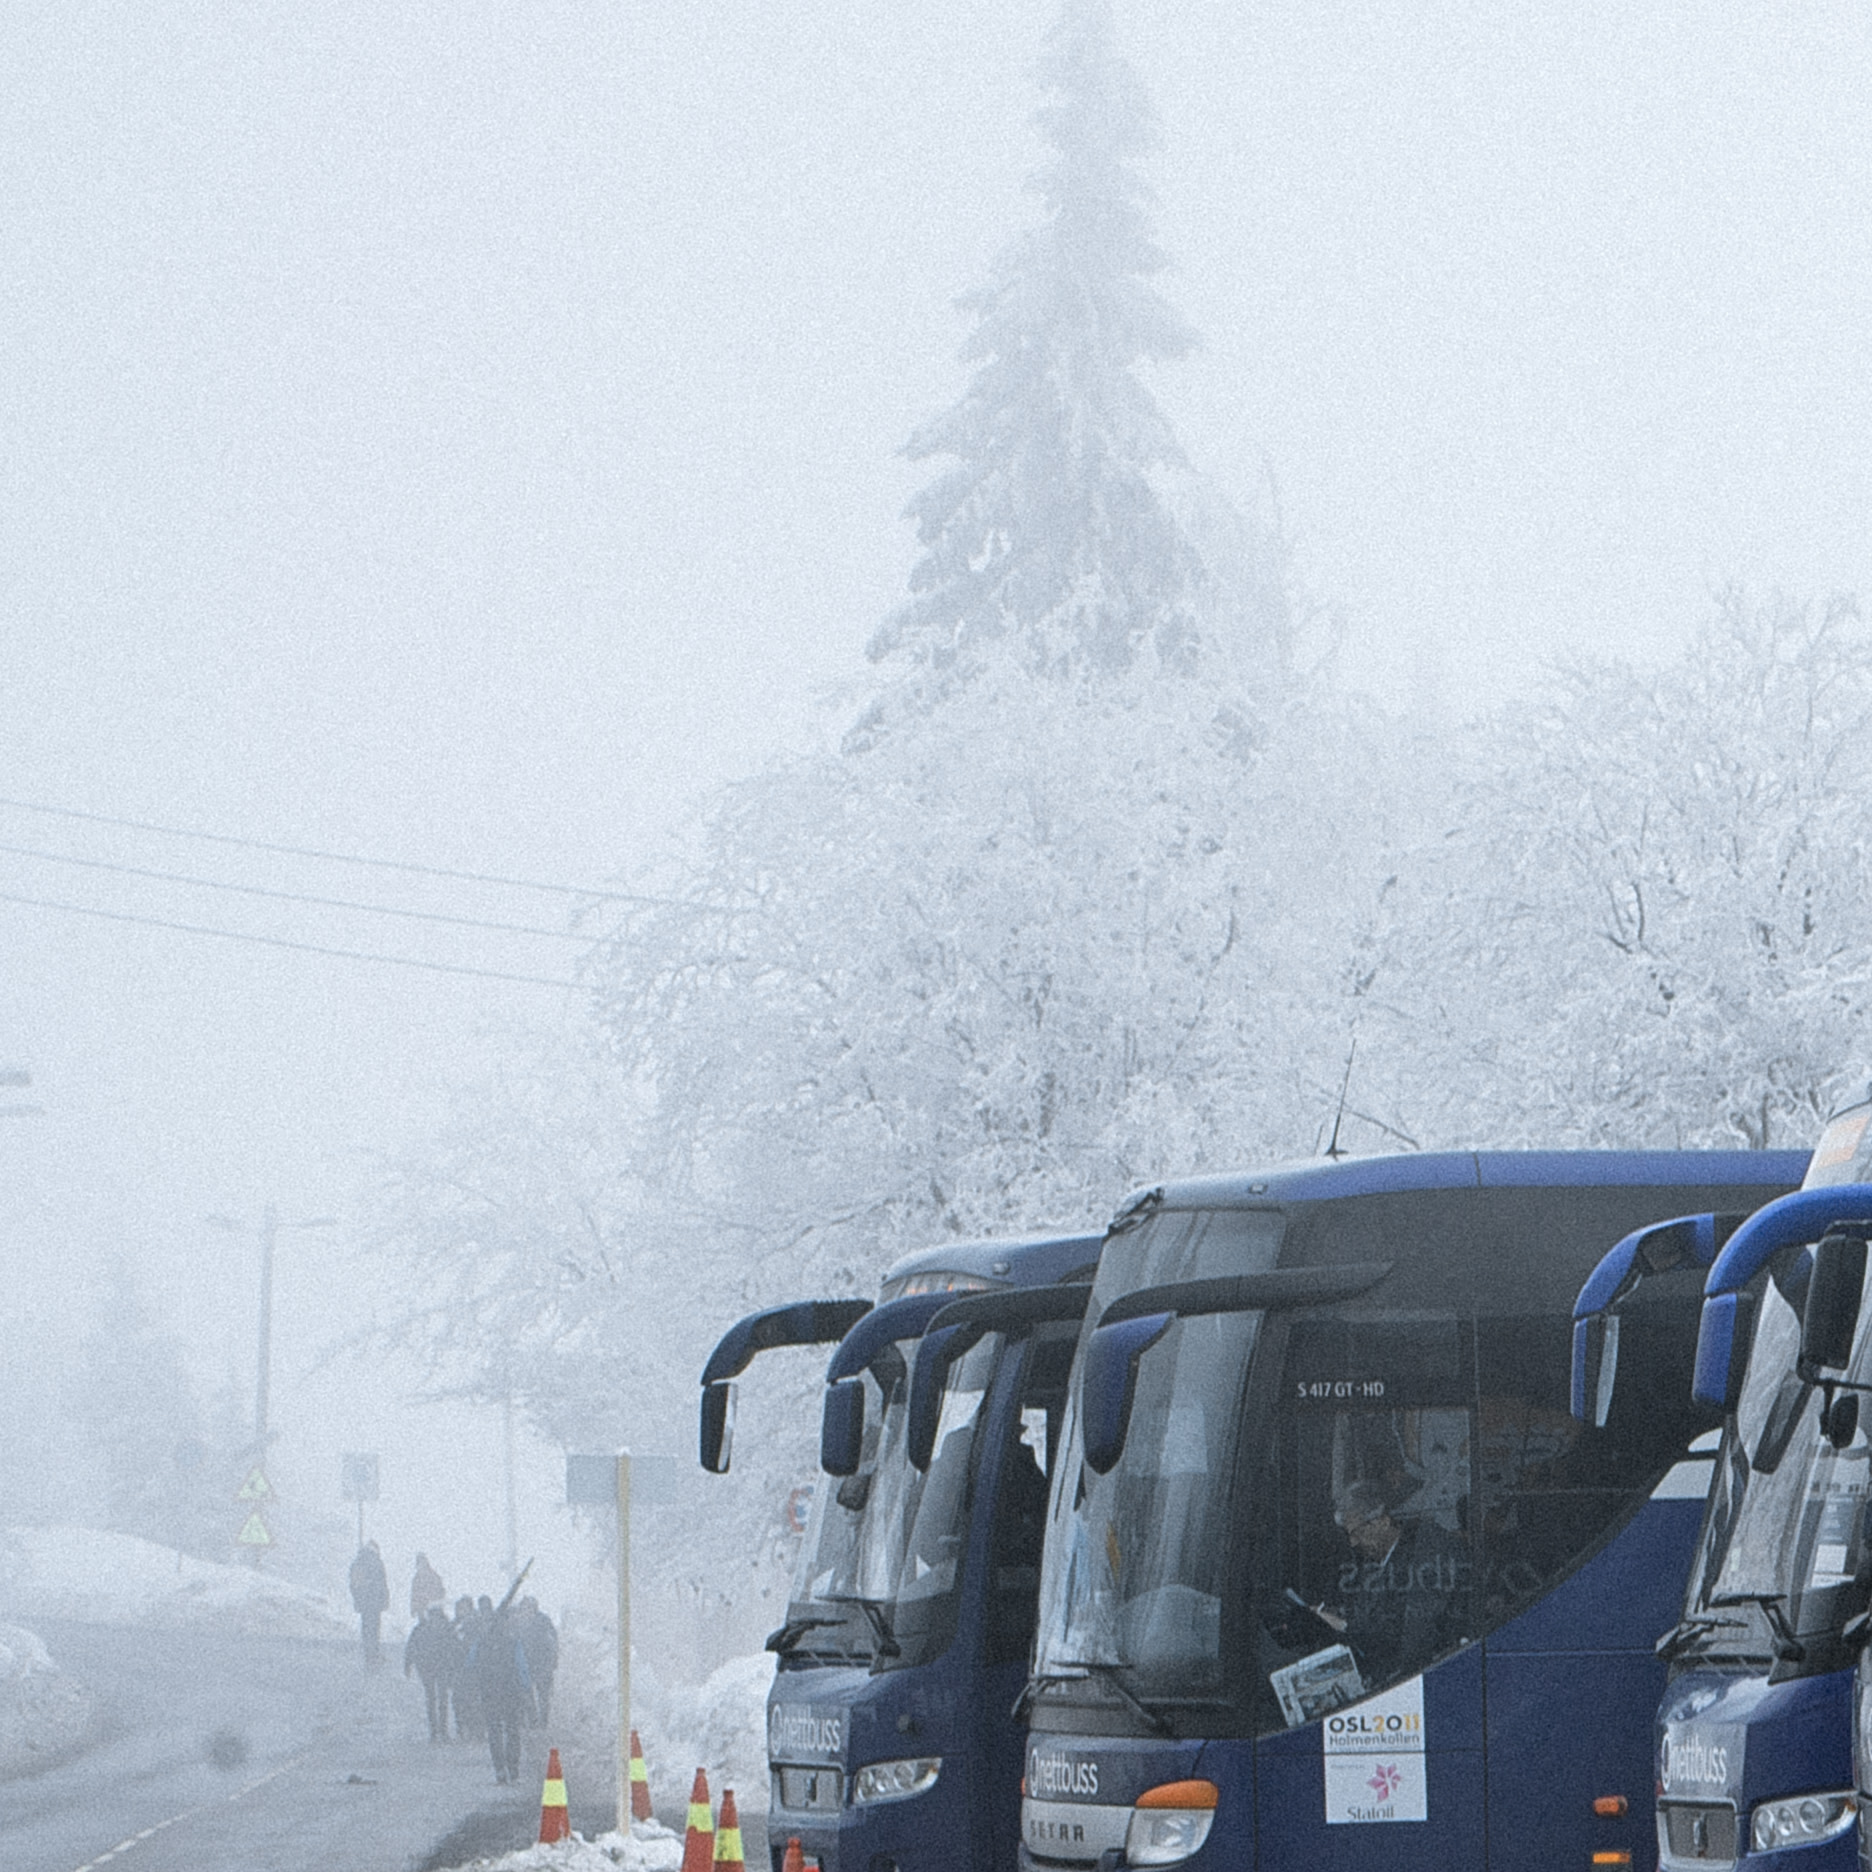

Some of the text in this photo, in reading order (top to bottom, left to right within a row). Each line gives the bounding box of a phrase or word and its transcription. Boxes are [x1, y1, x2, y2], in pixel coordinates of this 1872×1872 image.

[1298, 1382, 1307, 1397] S
[1310, 1382, 1331, 1397] 417
[1330, 1733, 1420, 1746] Holmenkollen
[1039, 1753, 1099, 1794] nettbuss
[1347, 1805, 1395, 1820] Statoil
